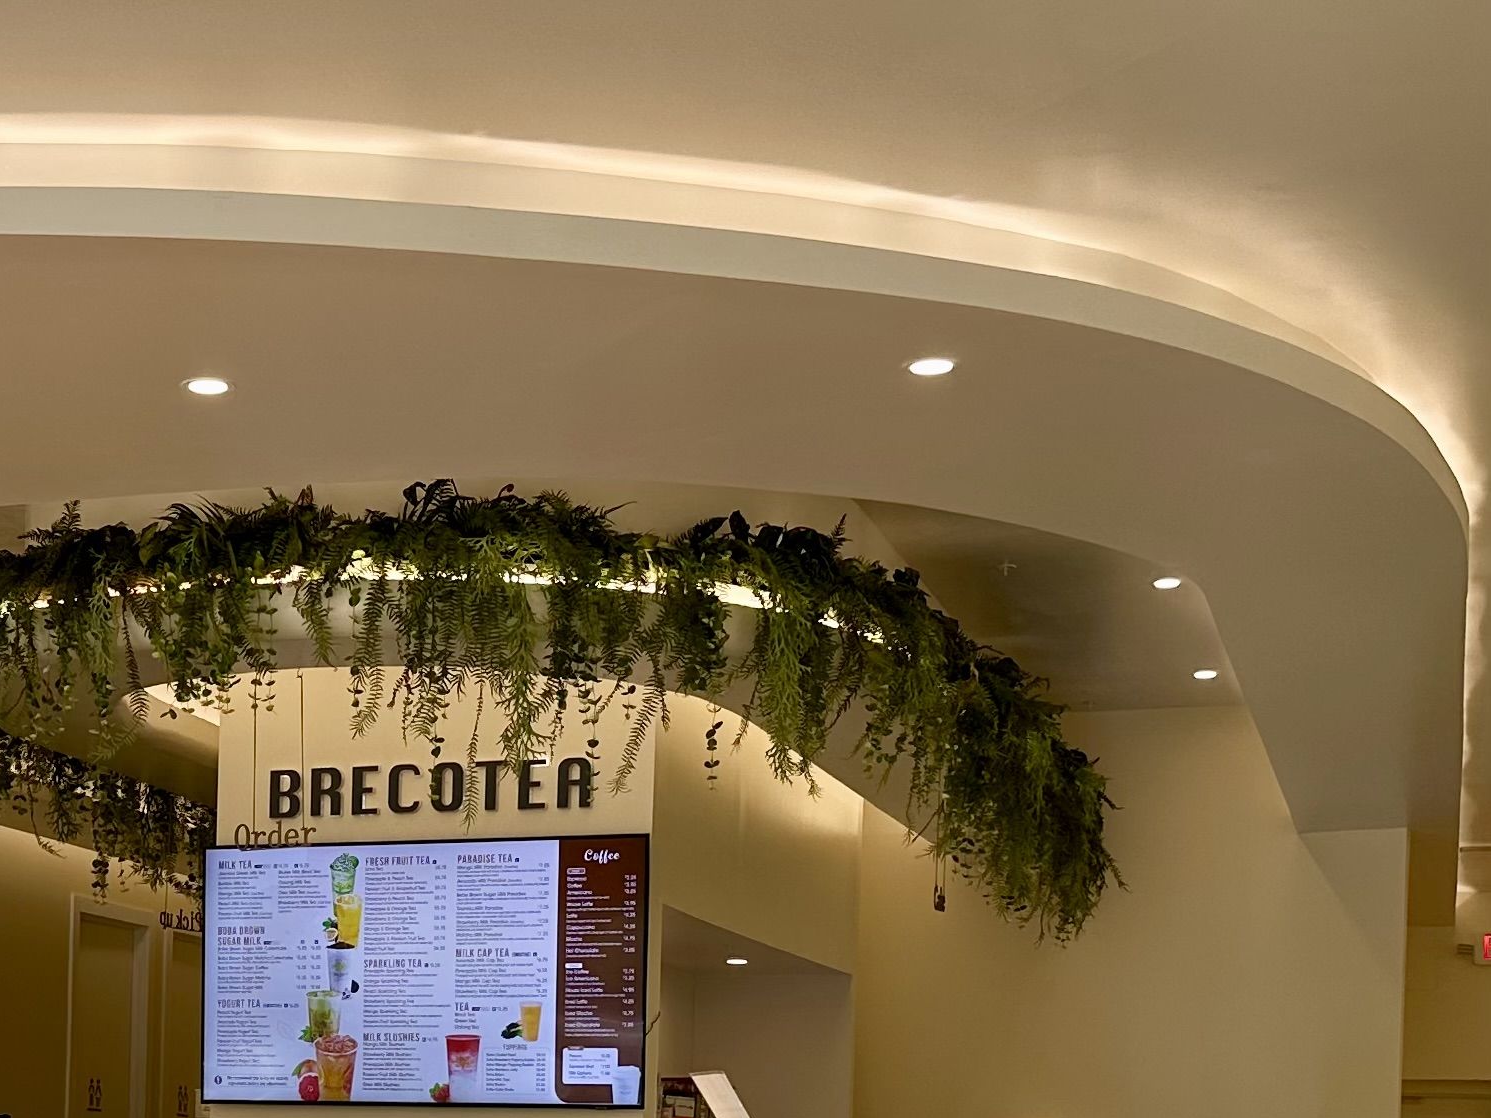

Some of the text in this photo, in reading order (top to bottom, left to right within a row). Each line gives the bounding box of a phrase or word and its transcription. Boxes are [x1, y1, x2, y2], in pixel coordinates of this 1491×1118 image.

[269, 757, 592, 820] BRECOTEA
[234, 820, 317, 852] Order
[365, 855, 430, 866] FRESH FRUIT TEA
[457, 853, 513, 864] PARADISE TEA
[584, 849, 620, 864] Coffee
[218, 860, 252, 870] MILK TEA
[218, 936, 261, 946] SUGAR MILK
[455, 948, 509, 958] MILK CAP TEA
[364, 959, 422, 969] SPARKLING TEA
[217, 999, 260, 1008] YOGURT TEA
[455, 1002, 469, 1011] TEA
[363, 1032, 420, 1042] MILK SLUSHIES
